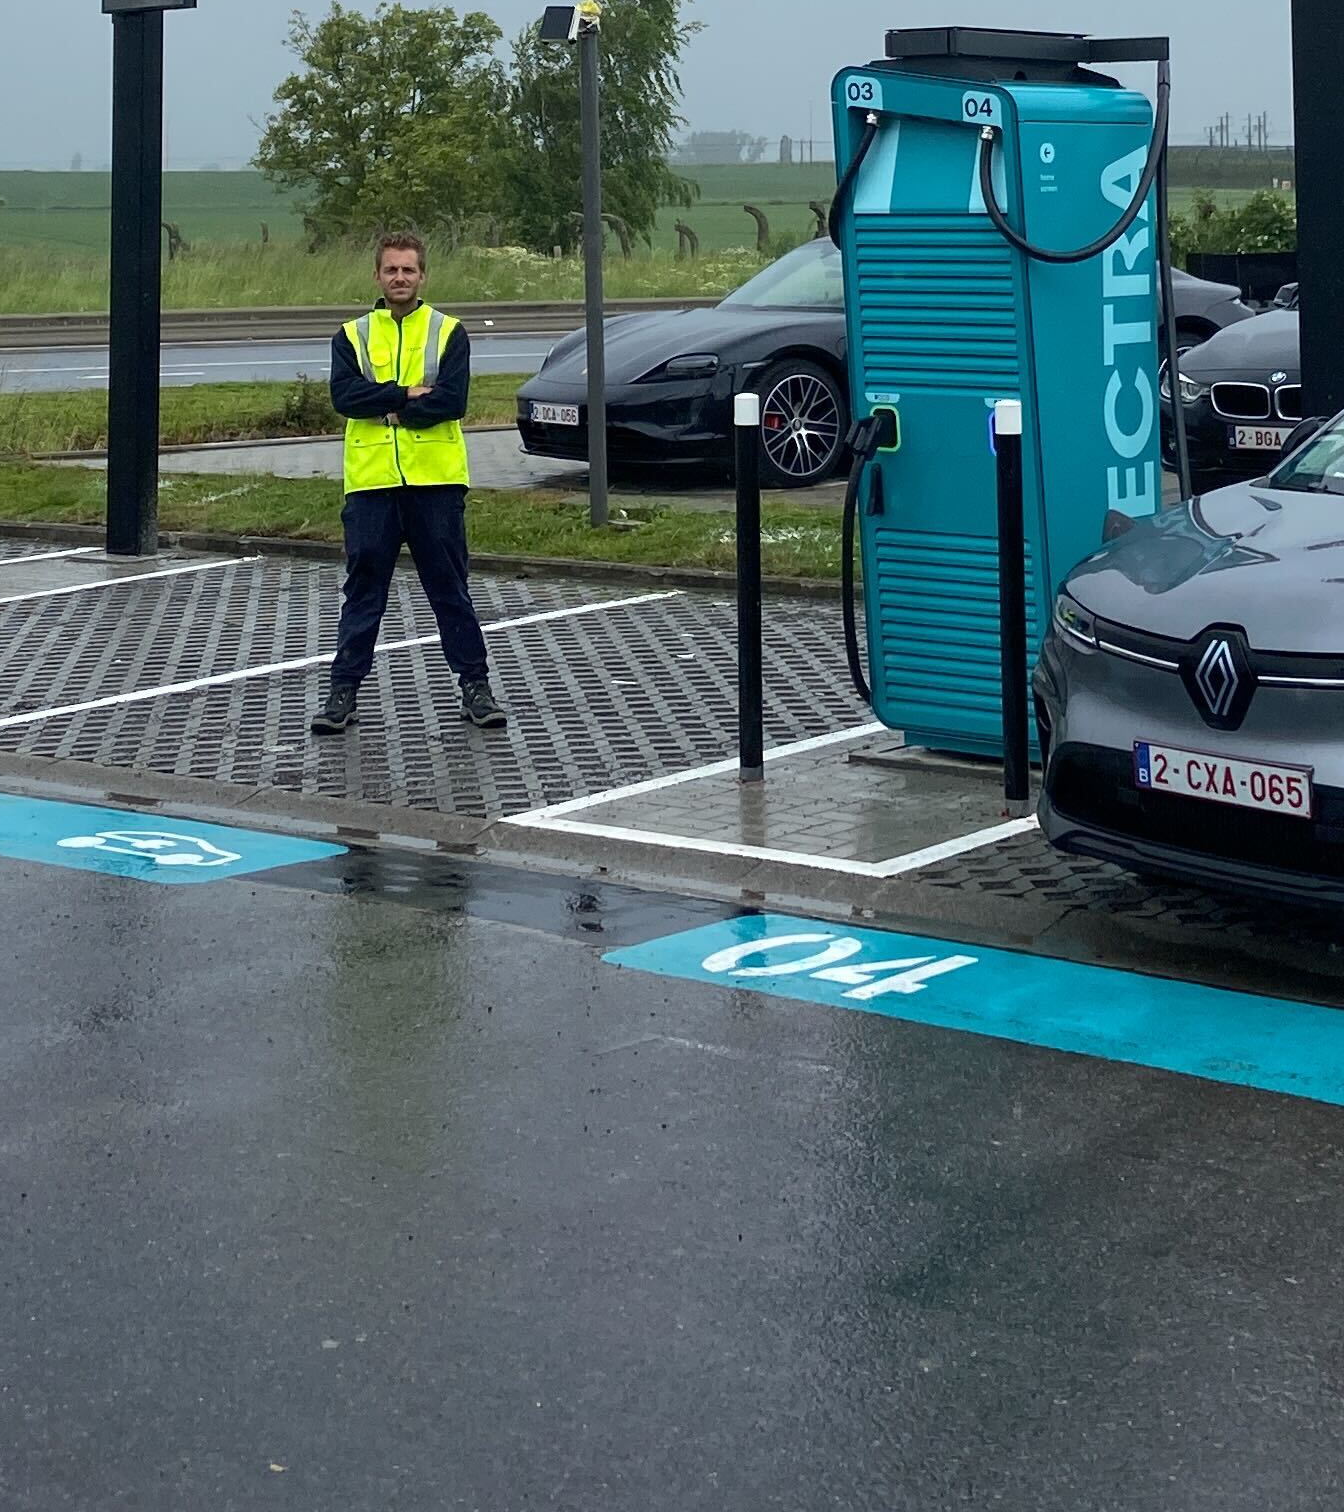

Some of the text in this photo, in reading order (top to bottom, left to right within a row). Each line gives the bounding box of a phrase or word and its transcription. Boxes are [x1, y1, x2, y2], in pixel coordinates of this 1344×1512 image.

[848, 82, 874, 101] 03
[964, 98, 993, 118] 04
[1101, 144, 1156, 519] ECTRA
[1237, 430, 1282, 447] 2-BGA
[1138, 754, 1303, 809] B 2-CXA-065
[701, 933, 979, 1000] 04
